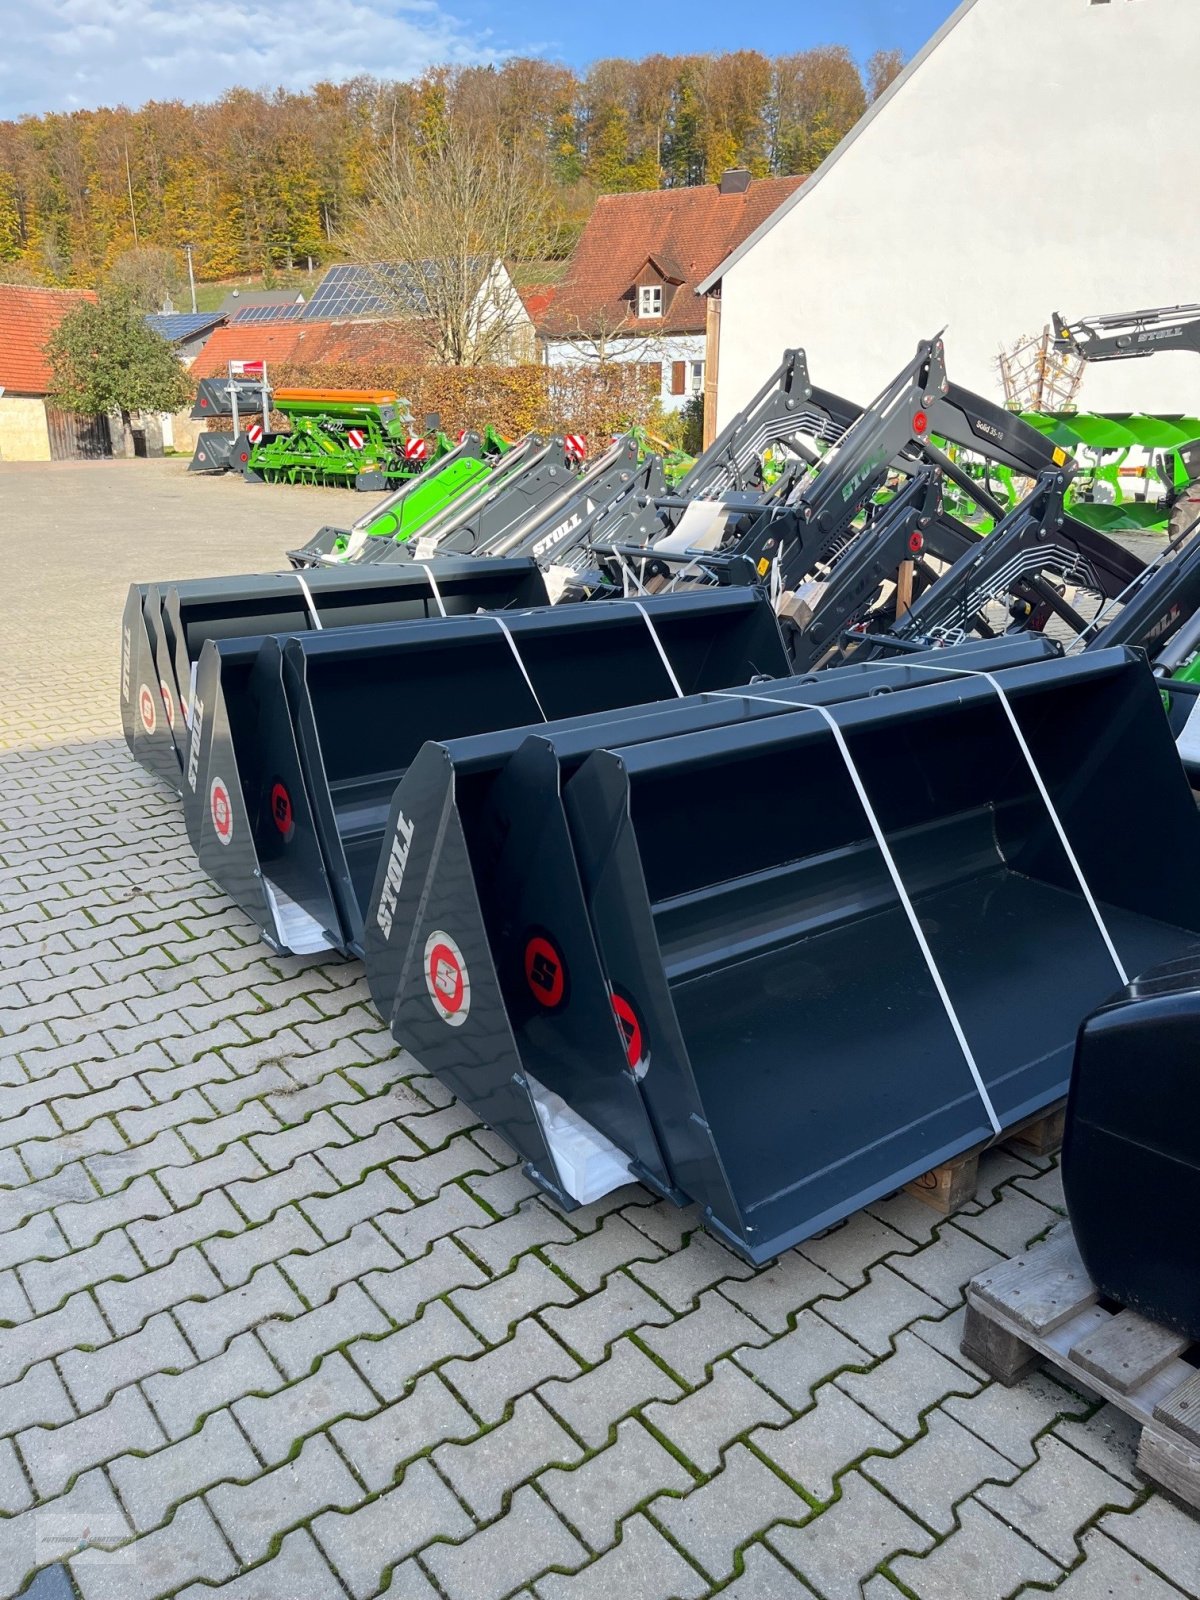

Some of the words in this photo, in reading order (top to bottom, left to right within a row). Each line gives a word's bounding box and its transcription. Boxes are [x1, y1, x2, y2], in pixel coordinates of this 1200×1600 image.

[1138, 327, 1183, 342] STOLL
[532, 513, 582, 558] STOLL
[122, 624, 131, 703] STOLL
[188, 695, 204, 794] STOLL
[376, 810, 415, 941] STOLL
